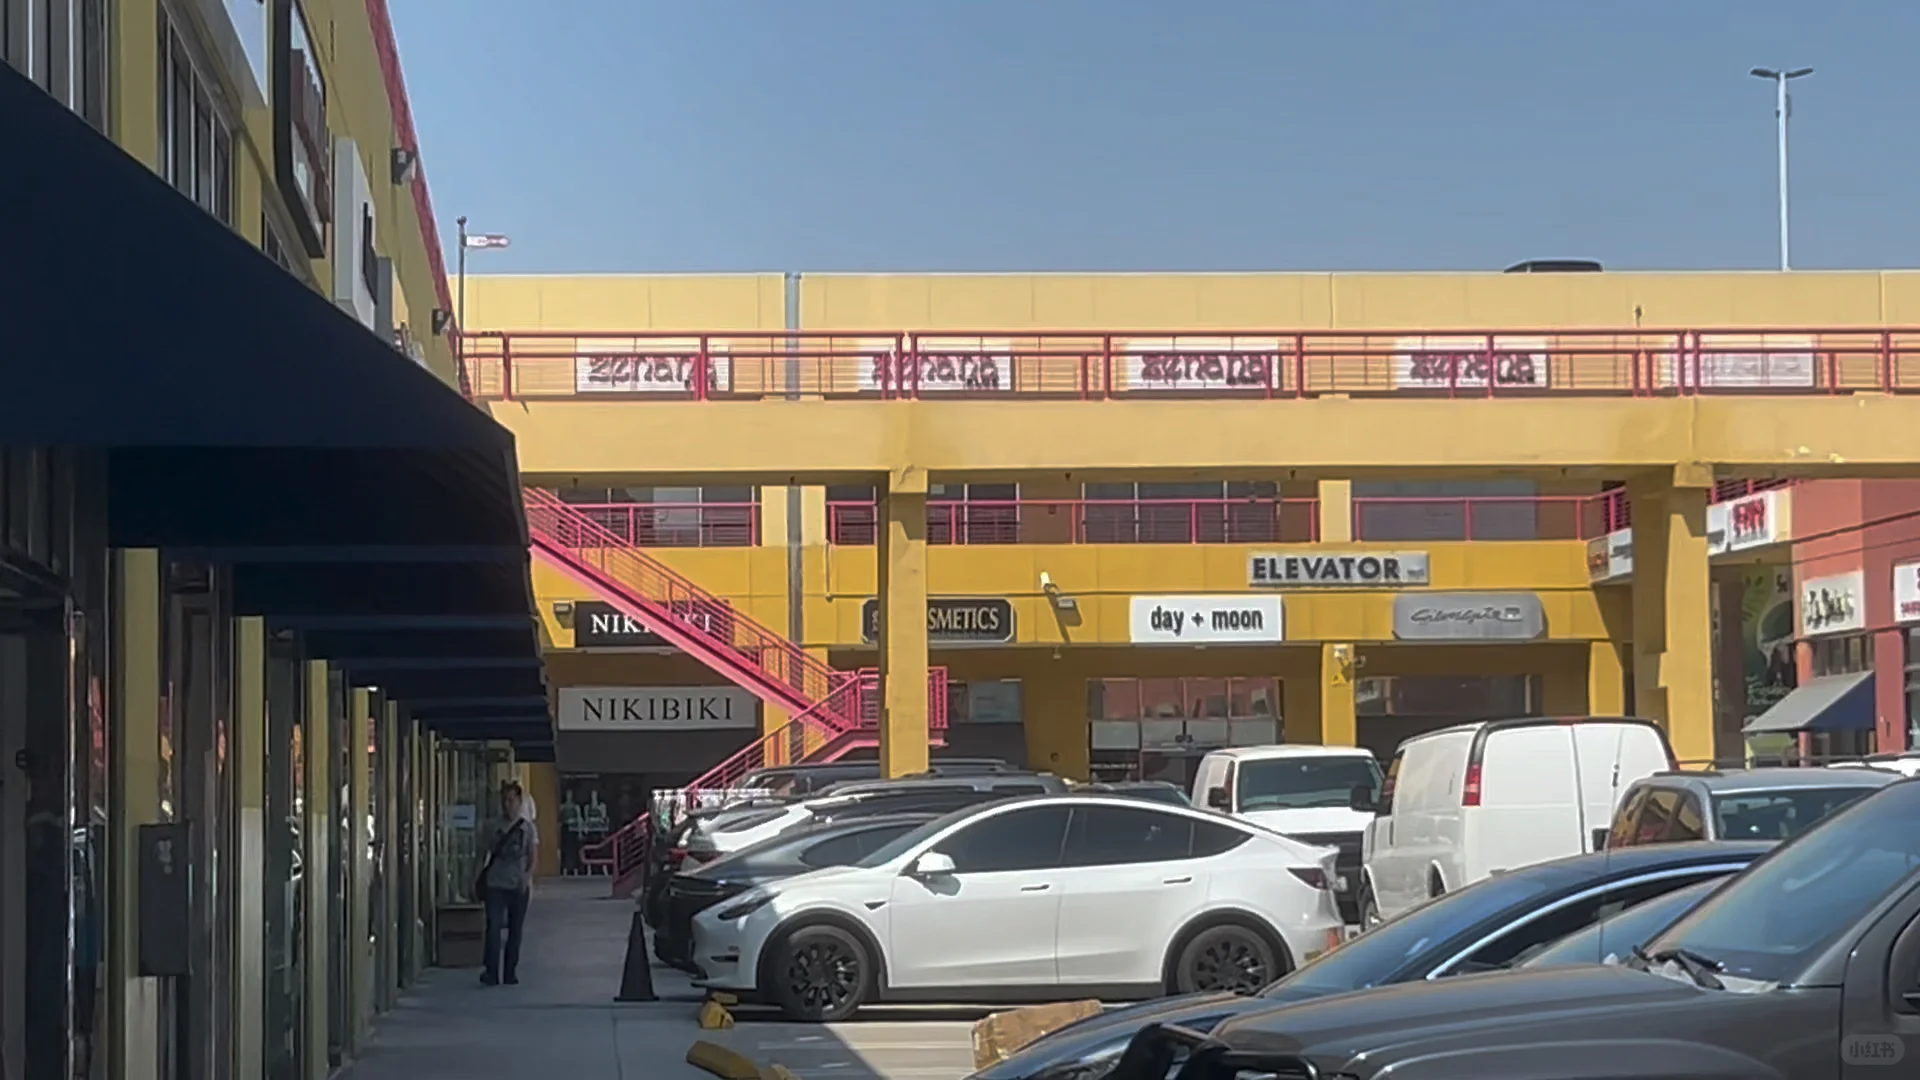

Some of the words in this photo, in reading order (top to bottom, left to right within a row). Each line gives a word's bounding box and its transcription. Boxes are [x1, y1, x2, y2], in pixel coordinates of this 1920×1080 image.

[1252, 556, 1400, 580] ELEVATOR
[1150, 605, 1184, 637] day
[1191, 611, 1204, 628] +
[1211, 609, 1264, 631] moon
[582, 697, 733, 721] NIKIBIKI
